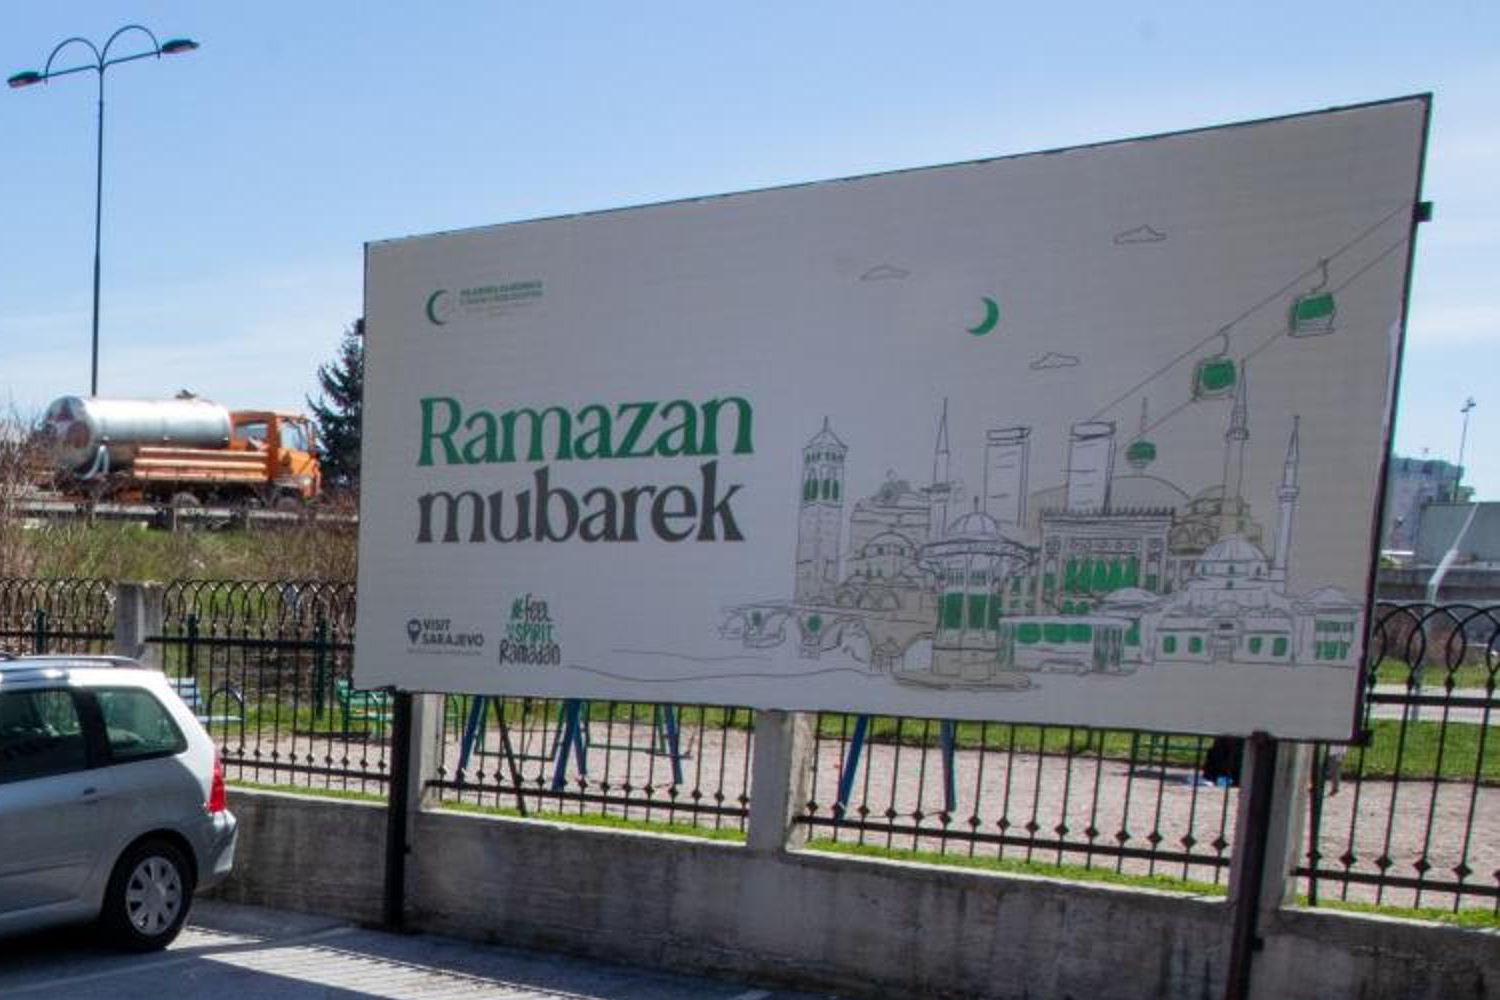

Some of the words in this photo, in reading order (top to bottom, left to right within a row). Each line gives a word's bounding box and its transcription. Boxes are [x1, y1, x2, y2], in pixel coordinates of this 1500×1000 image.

[417, 395, 755, 467] Ramazan
[416, 461, 746, 543] mubarek
[422, 634, 485, 646] SARAJEVO
[423, 619, 451, 630] VISIT
